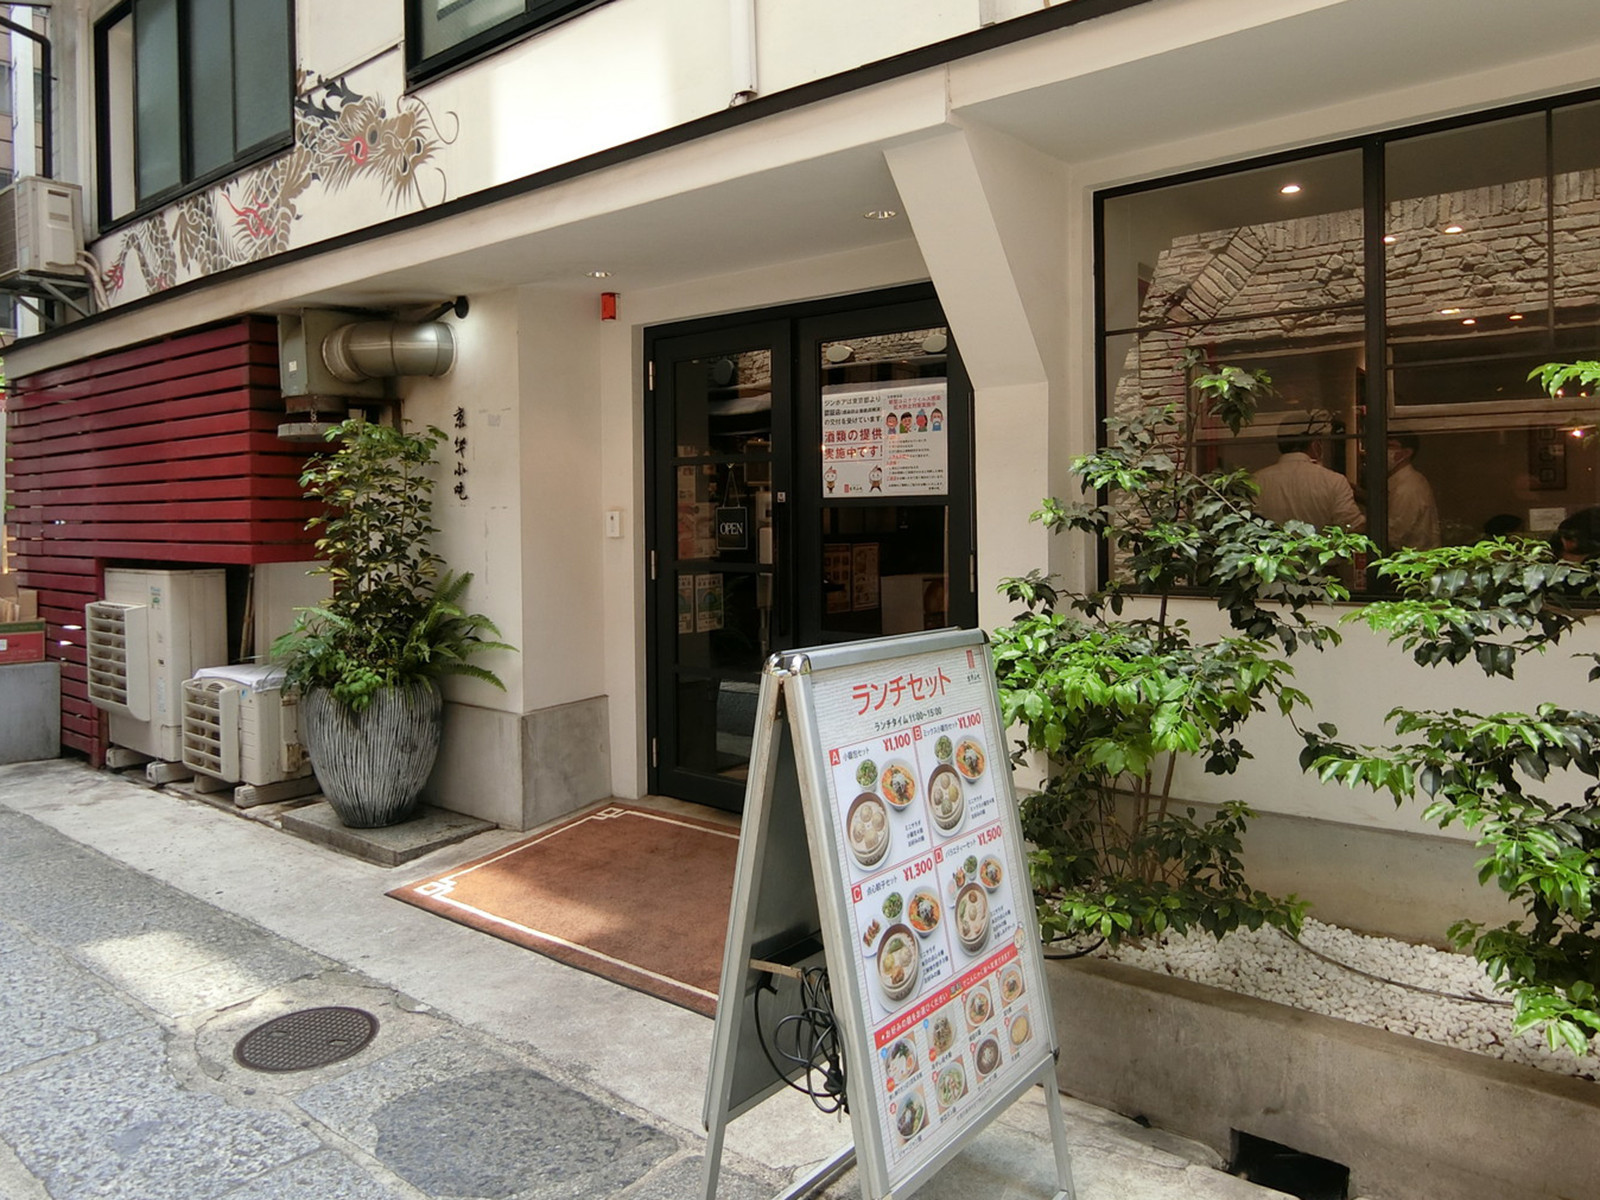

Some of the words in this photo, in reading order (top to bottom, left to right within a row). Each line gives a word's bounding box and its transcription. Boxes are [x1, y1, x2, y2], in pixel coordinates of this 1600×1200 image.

[825, 428, 882, 443] 酒類の提供
[825, 444, 883, 459] 実施中です!
[719, 522, 744, 535] OPEN
[852, 666, 951, 715] ランチセット
[874, 716, 909, 732] ランチタイム
[958, 712, 982, 730] ¥1,100
[914, 728, 922, 739] B
[883, 733, 911, 753] ¥1,100
[830, 752, 840, 764] A
[977, 825, 1003, 847] ¥1,500
[903, 858, 933, 883] ¥1,300
[852, 887, 862, 902] C
